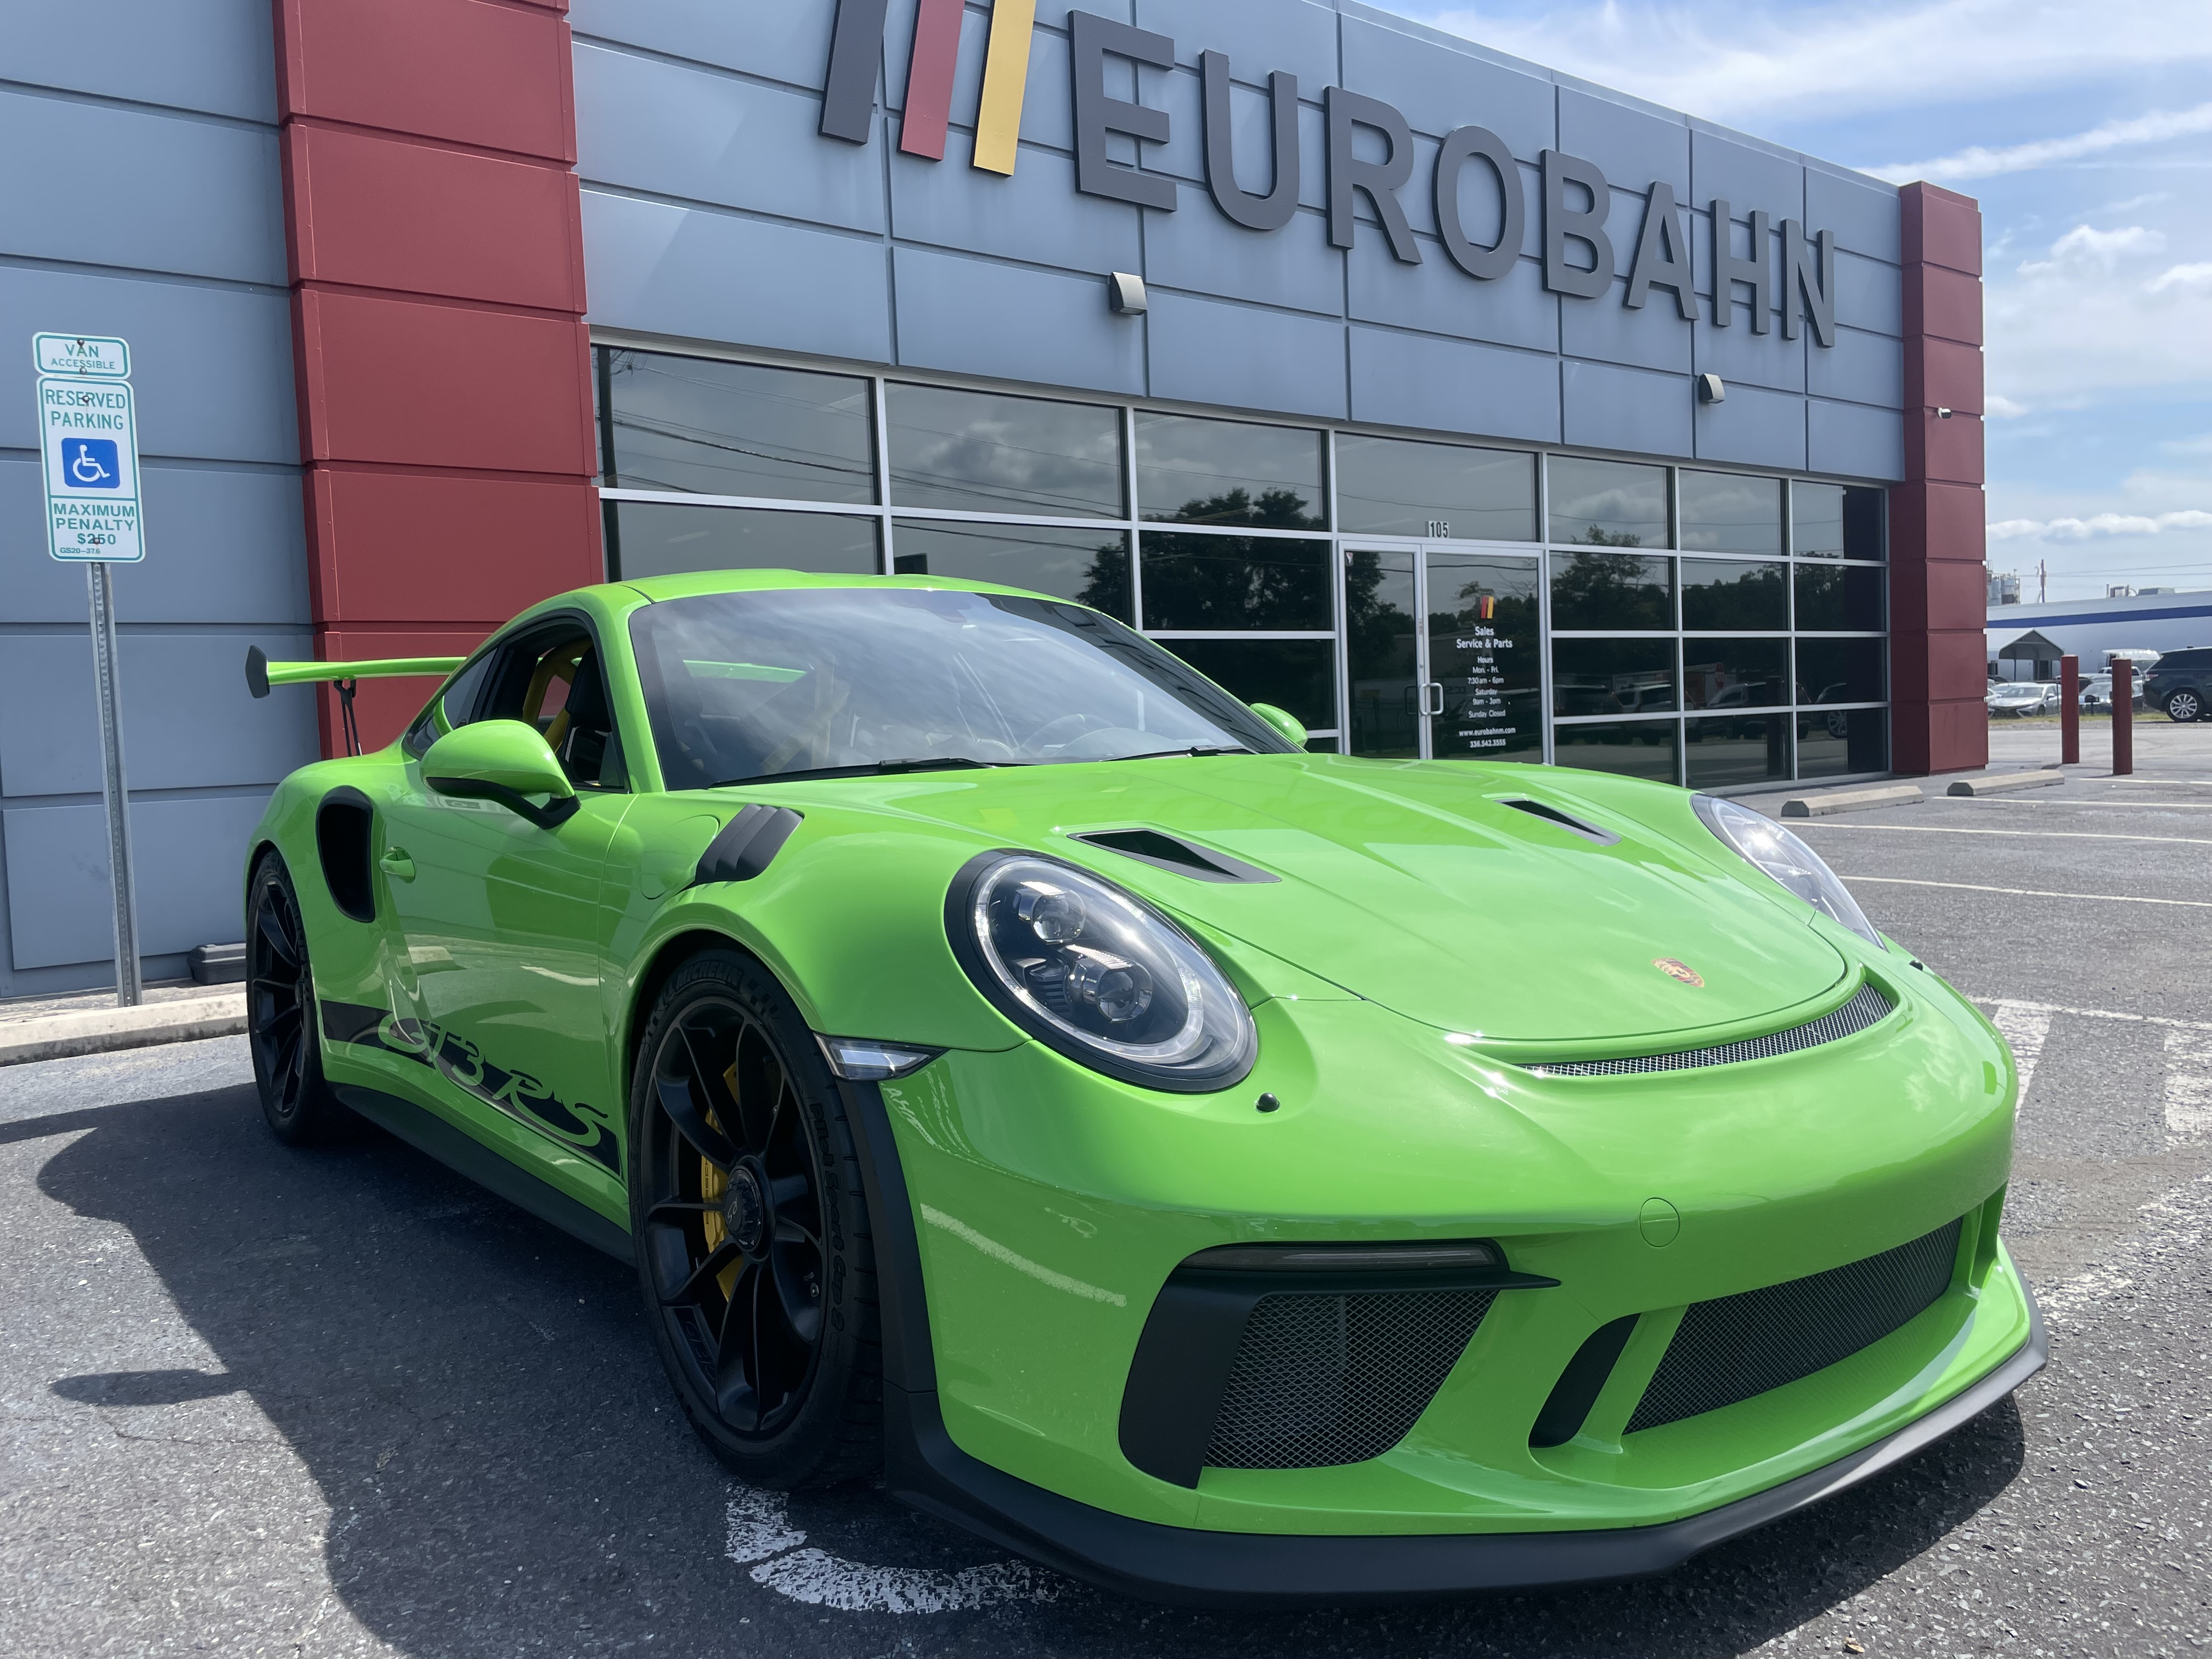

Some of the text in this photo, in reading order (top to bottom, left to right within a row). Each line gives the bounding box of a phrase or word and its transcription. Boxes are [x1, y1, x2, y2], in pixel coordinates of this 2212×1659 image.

[1068, 10, 1835, 348] EUROBAHN
[65, 344, 99, 358] VAN
[51, 358, 116, 370] ACCESSIBLE
[45, 388, 126, 409] RESERVED
[51, 410, 124, 430] PARKING
[54, 503, 135, 517] MAXIMUM
[56, 517, 135, 531] PENALTY
[1430, 522, 1448, 538] 105
[77, 532, 116, 545] $250
[1475, 625, 1494, 636] Sales
[1456, 638, 1513, 648] Service & Parts
[1475, 687, 1497, 696] Saturday
[1468, 710, 1487, 719] Sunday
[809, 1103, 847, 1332] Pilot Sport Cup 2
